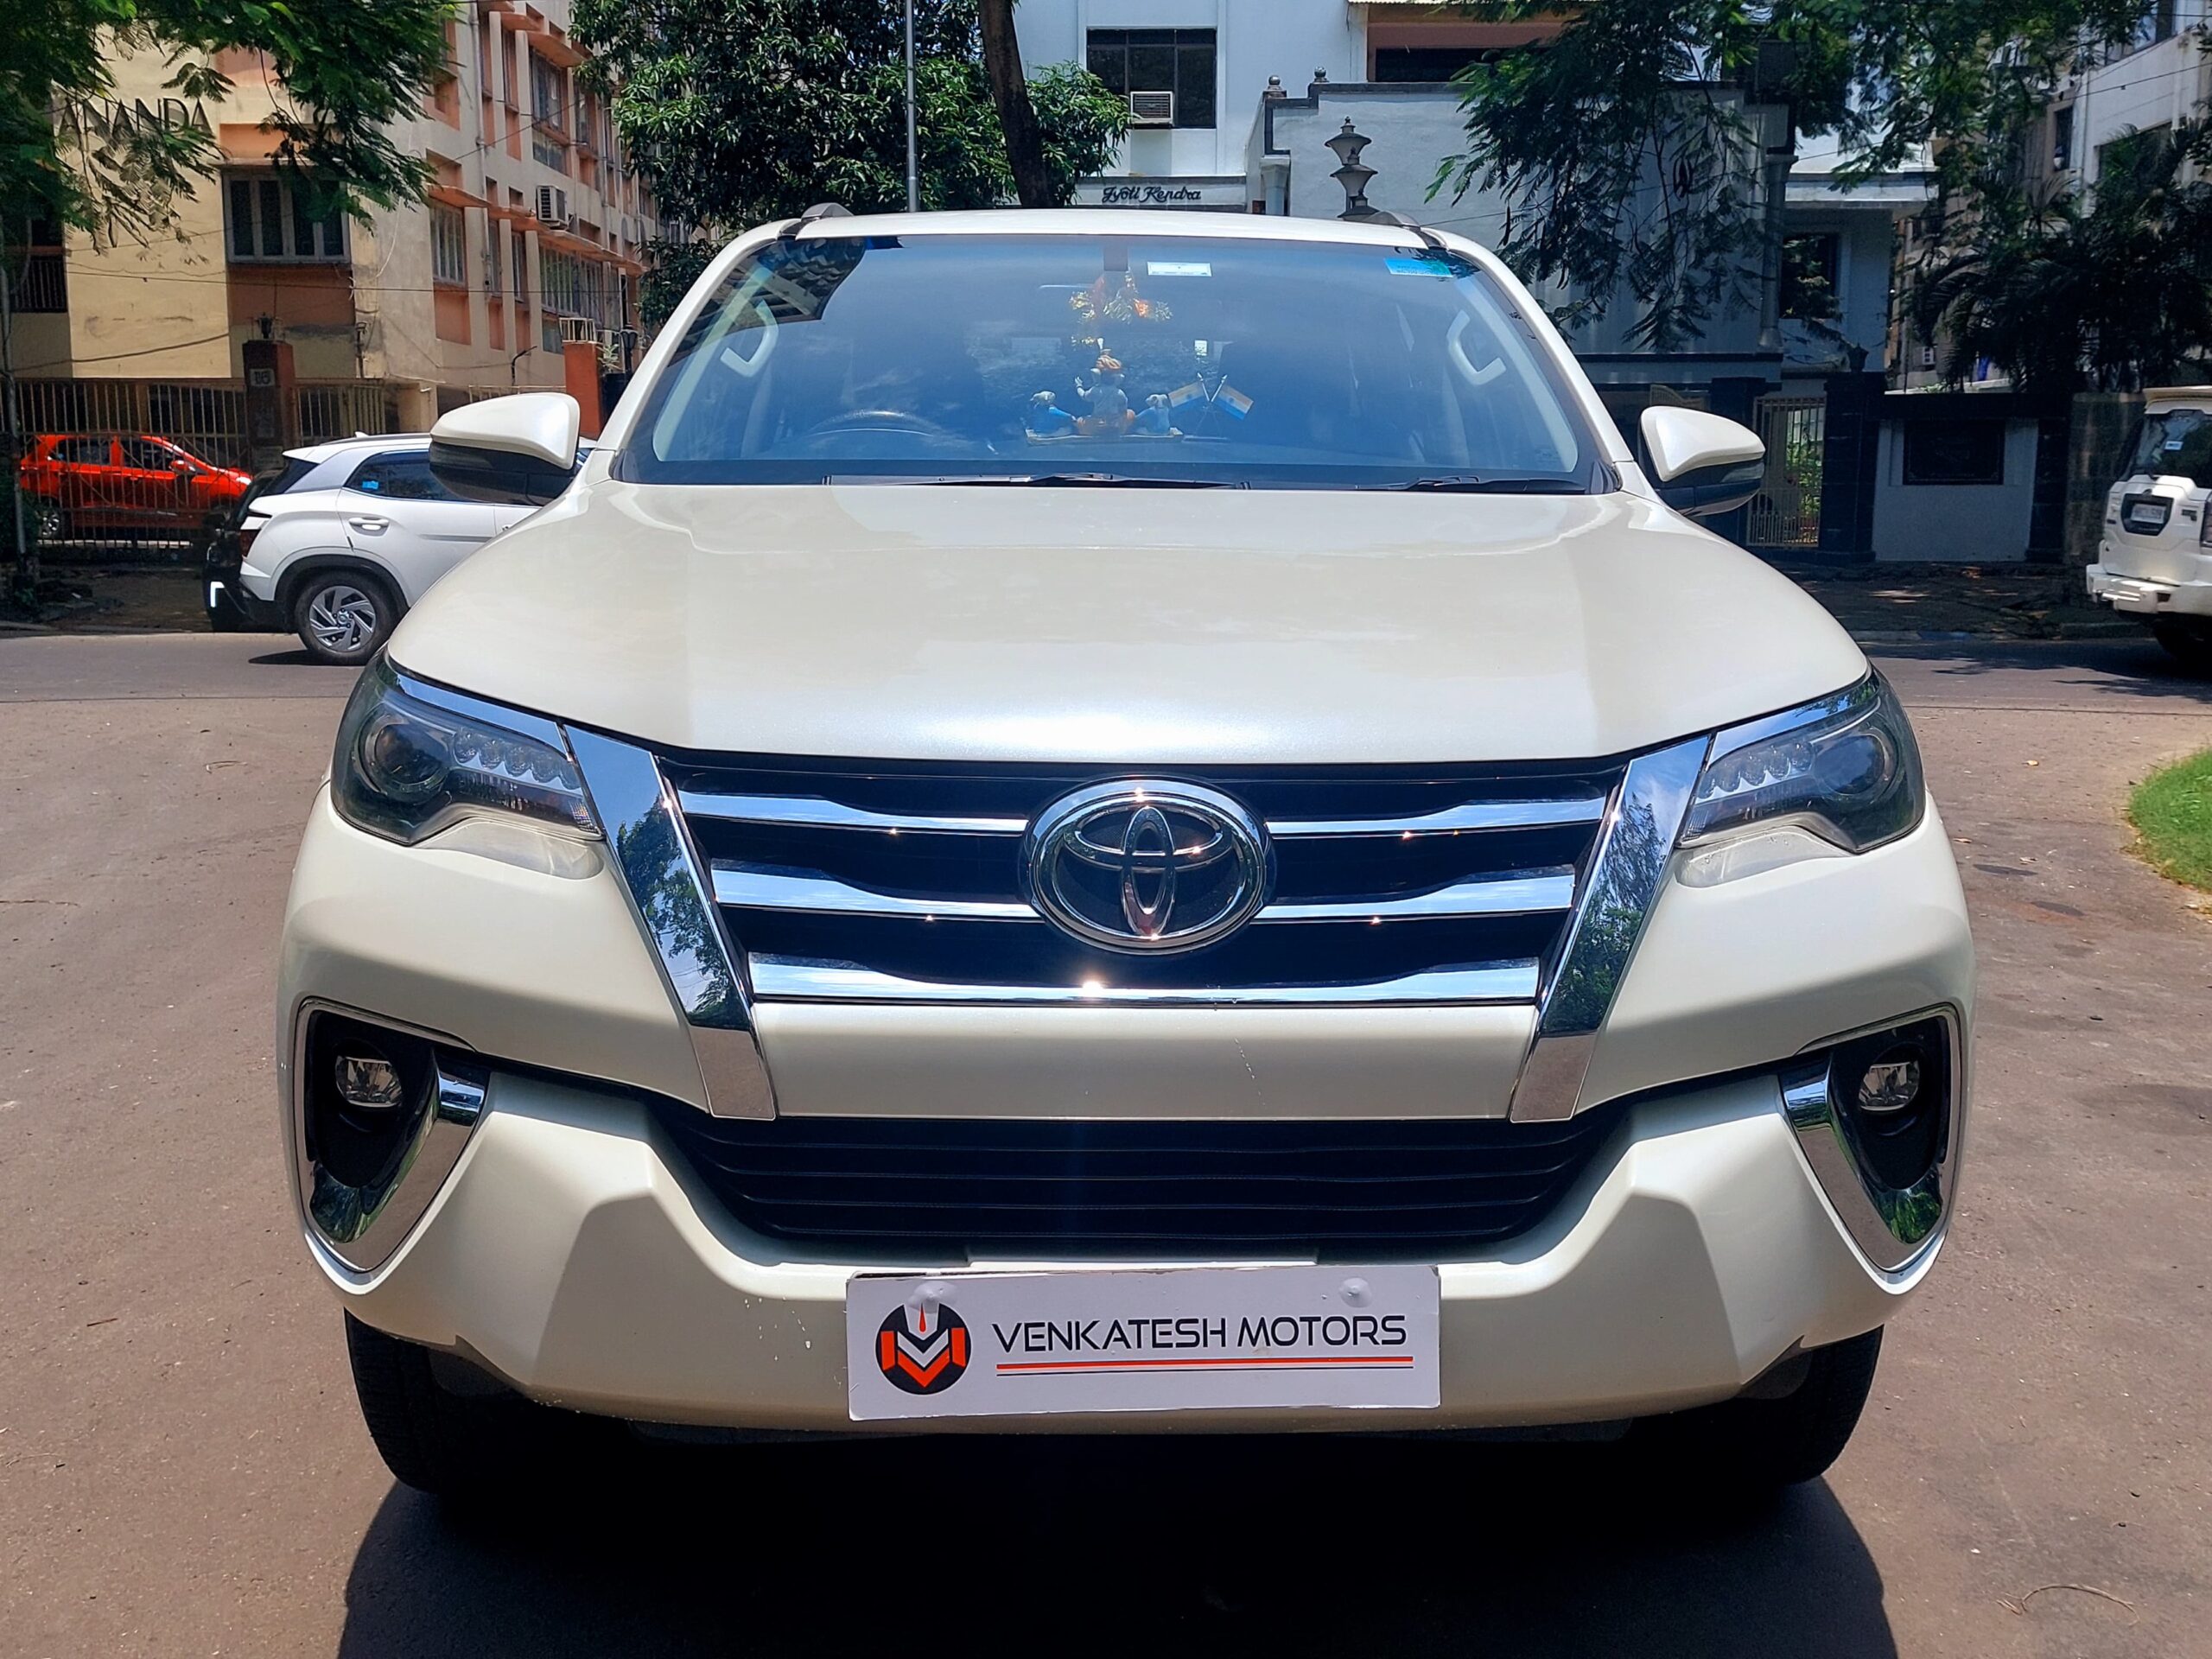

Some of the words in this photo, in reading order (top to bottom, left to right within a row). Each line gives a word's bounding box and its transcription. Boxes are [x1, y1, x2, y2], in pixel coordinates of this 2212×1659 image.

[1102, 186, 1141, 203] Jyoti
[1139, 186, 1202, 203] Kendra
[992, 1317, 1226, 1353] VENKATESH
[1237, 1315, 1407, 1346] MOTORS
